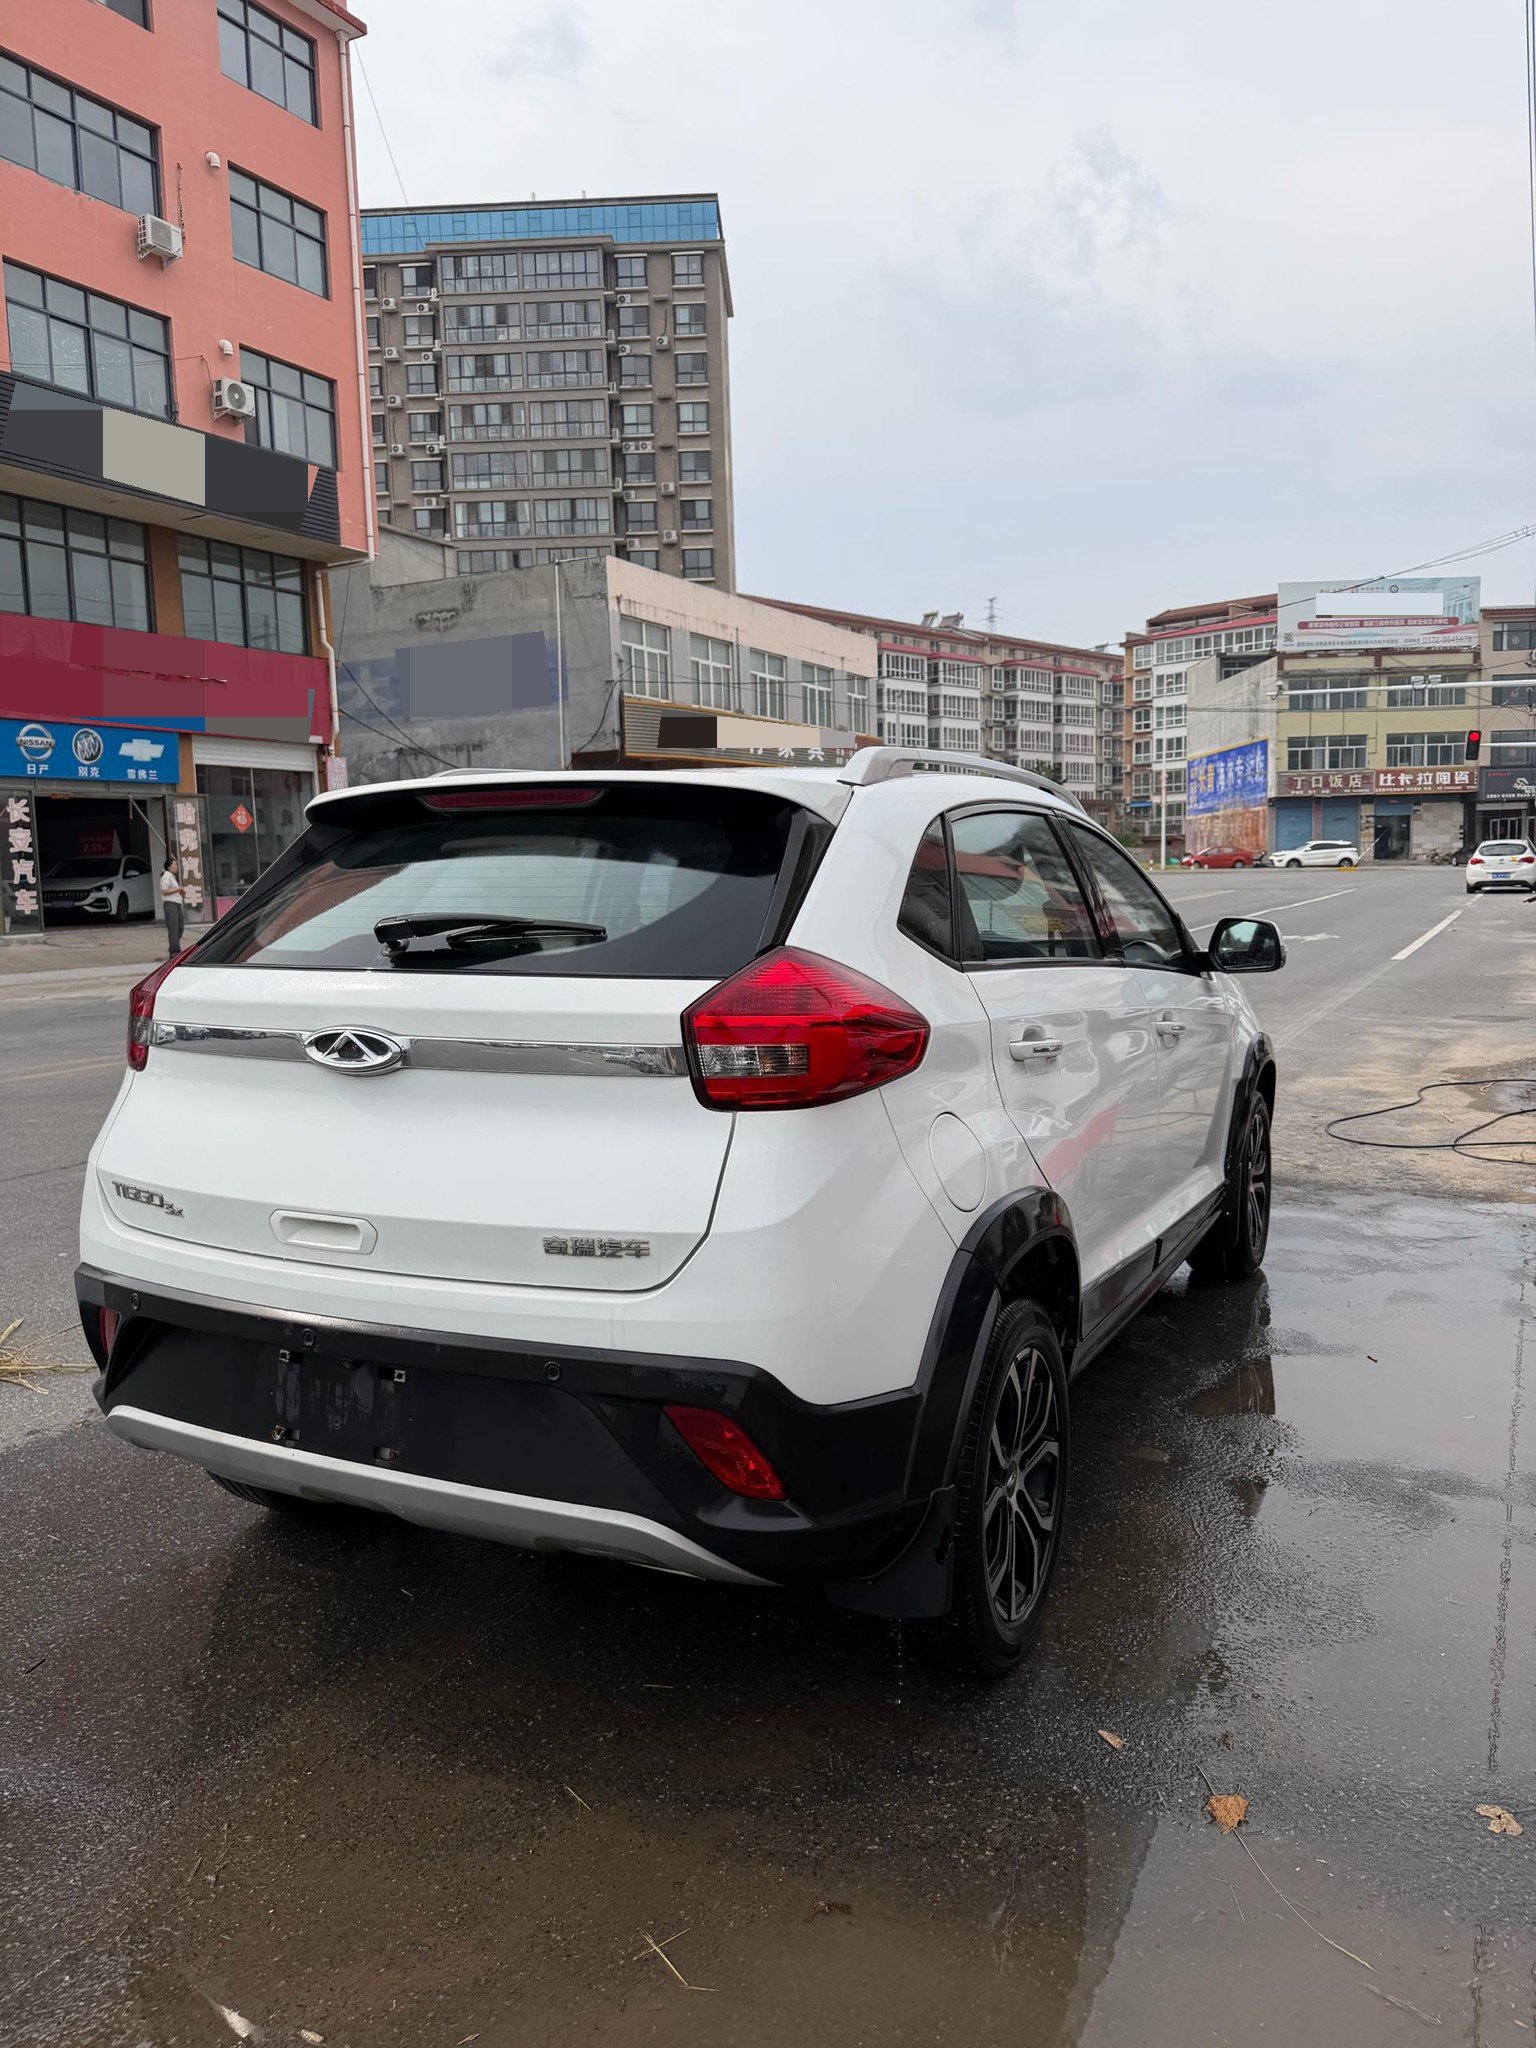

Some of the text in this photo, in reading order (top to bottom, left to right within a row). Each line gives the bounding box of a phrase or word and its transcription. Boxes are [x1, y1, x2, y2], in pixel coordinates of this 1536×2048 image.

[19, 738, 53, 748] NISSAN
[26, 764, 49, 775] 日产
[78, 766, 100, 778] 别克
[127, 768, 158, 780] 雪佛兰
[176, 802, 204, 908] 哈弗汽车
[541, 1235, 651, 1258] 奇瑞汽车
